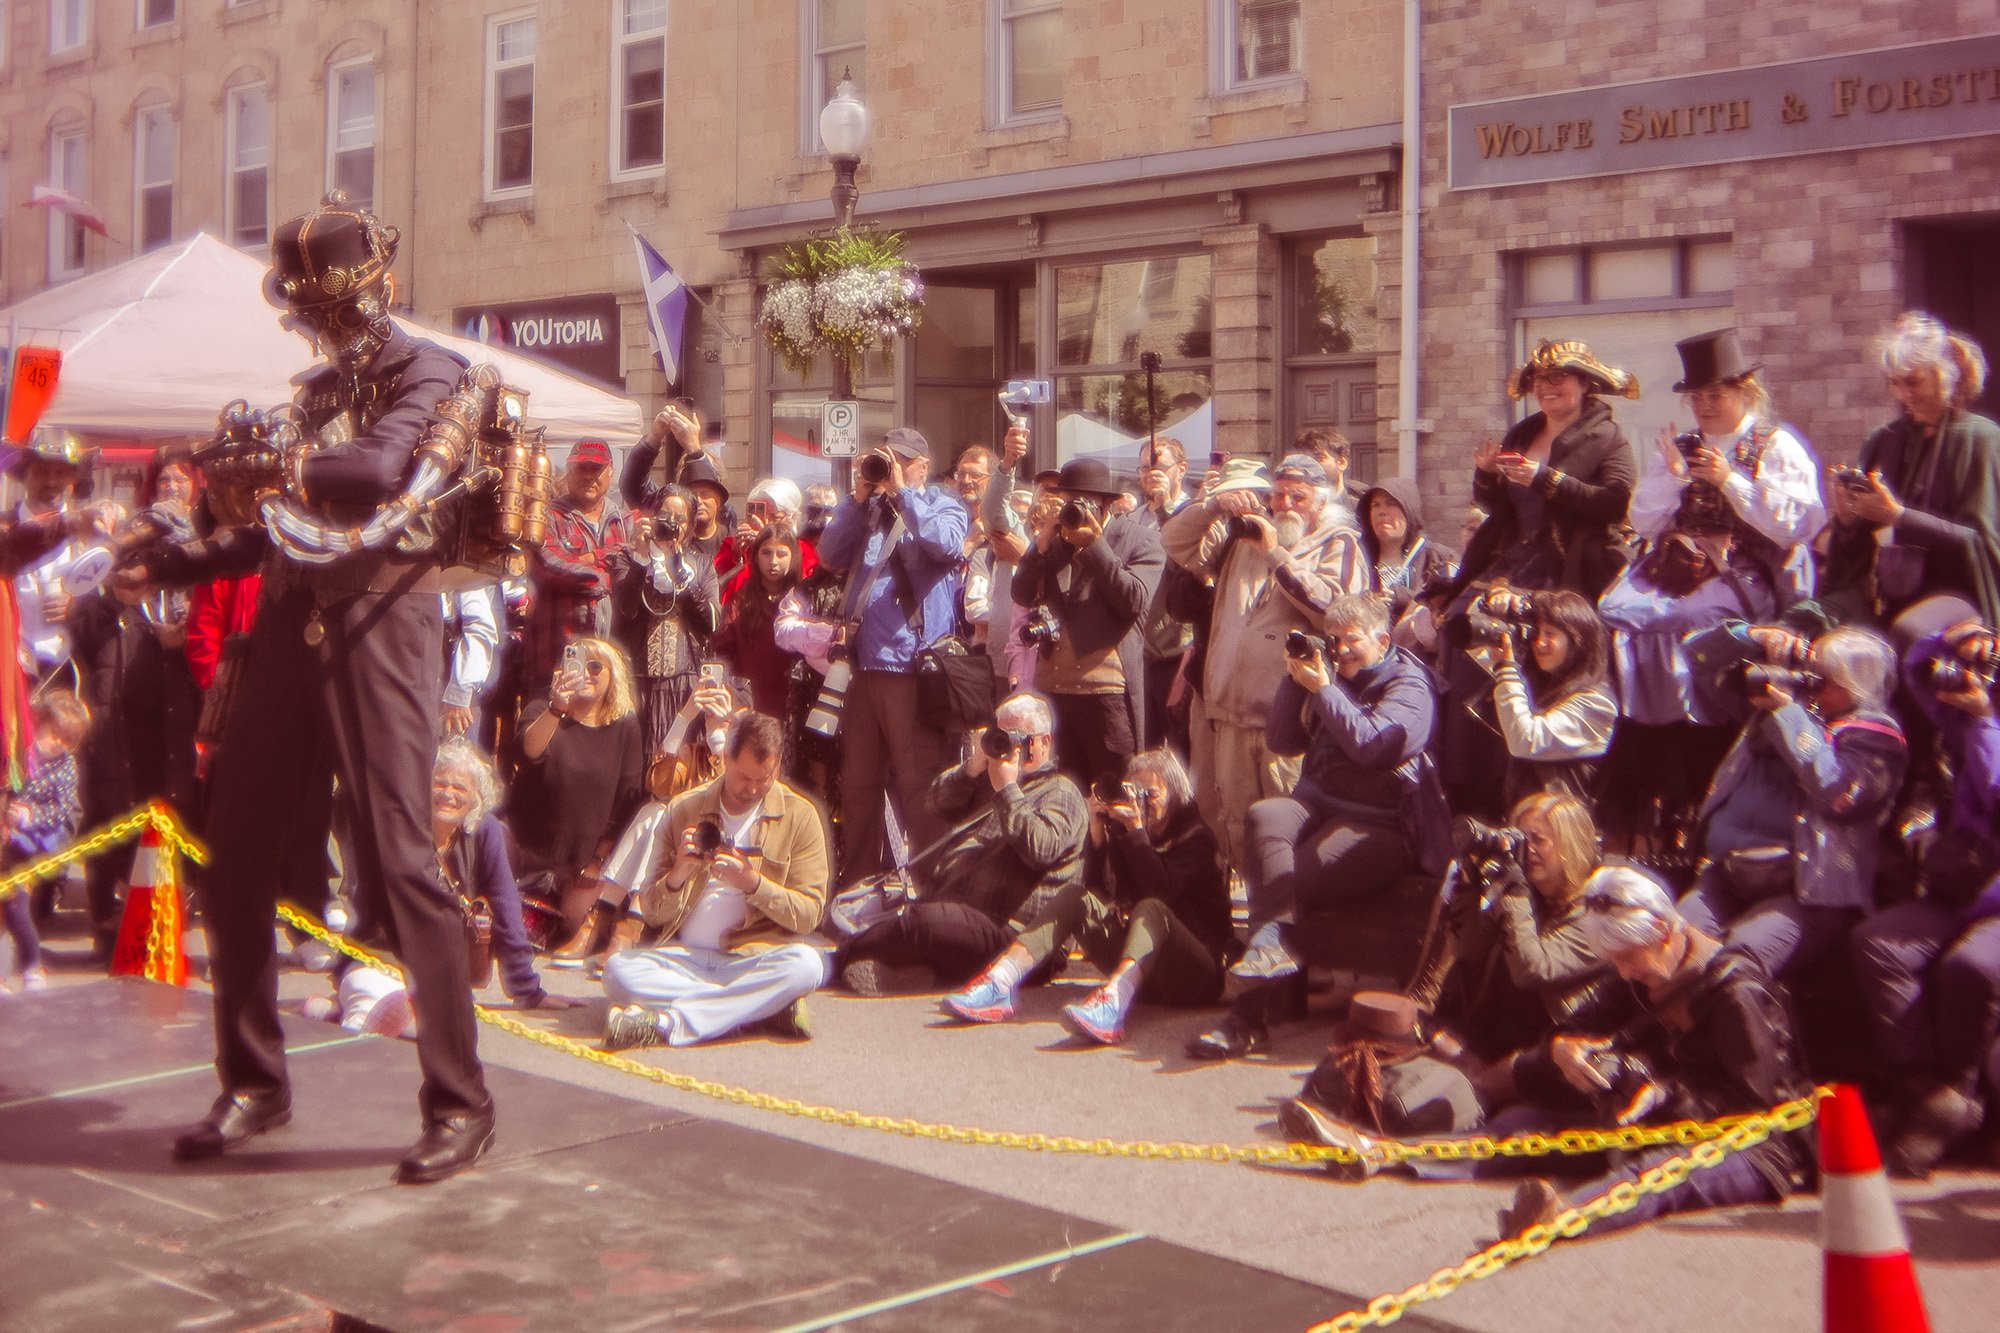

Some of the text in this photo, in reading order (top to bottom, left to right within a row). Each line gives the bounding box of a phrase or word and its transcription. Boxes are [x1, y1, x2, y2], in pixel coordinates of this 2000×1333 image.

[1474, 119, 1594, 159] WOLFE
[1619, 100, 1751, 144] SMITH
[1780, 92, 1809, 124] &
[512, 318, 603, 347] YOUTOPIA
[27, 367, 48, 388] 45
[836, 410, 847, 423] P
